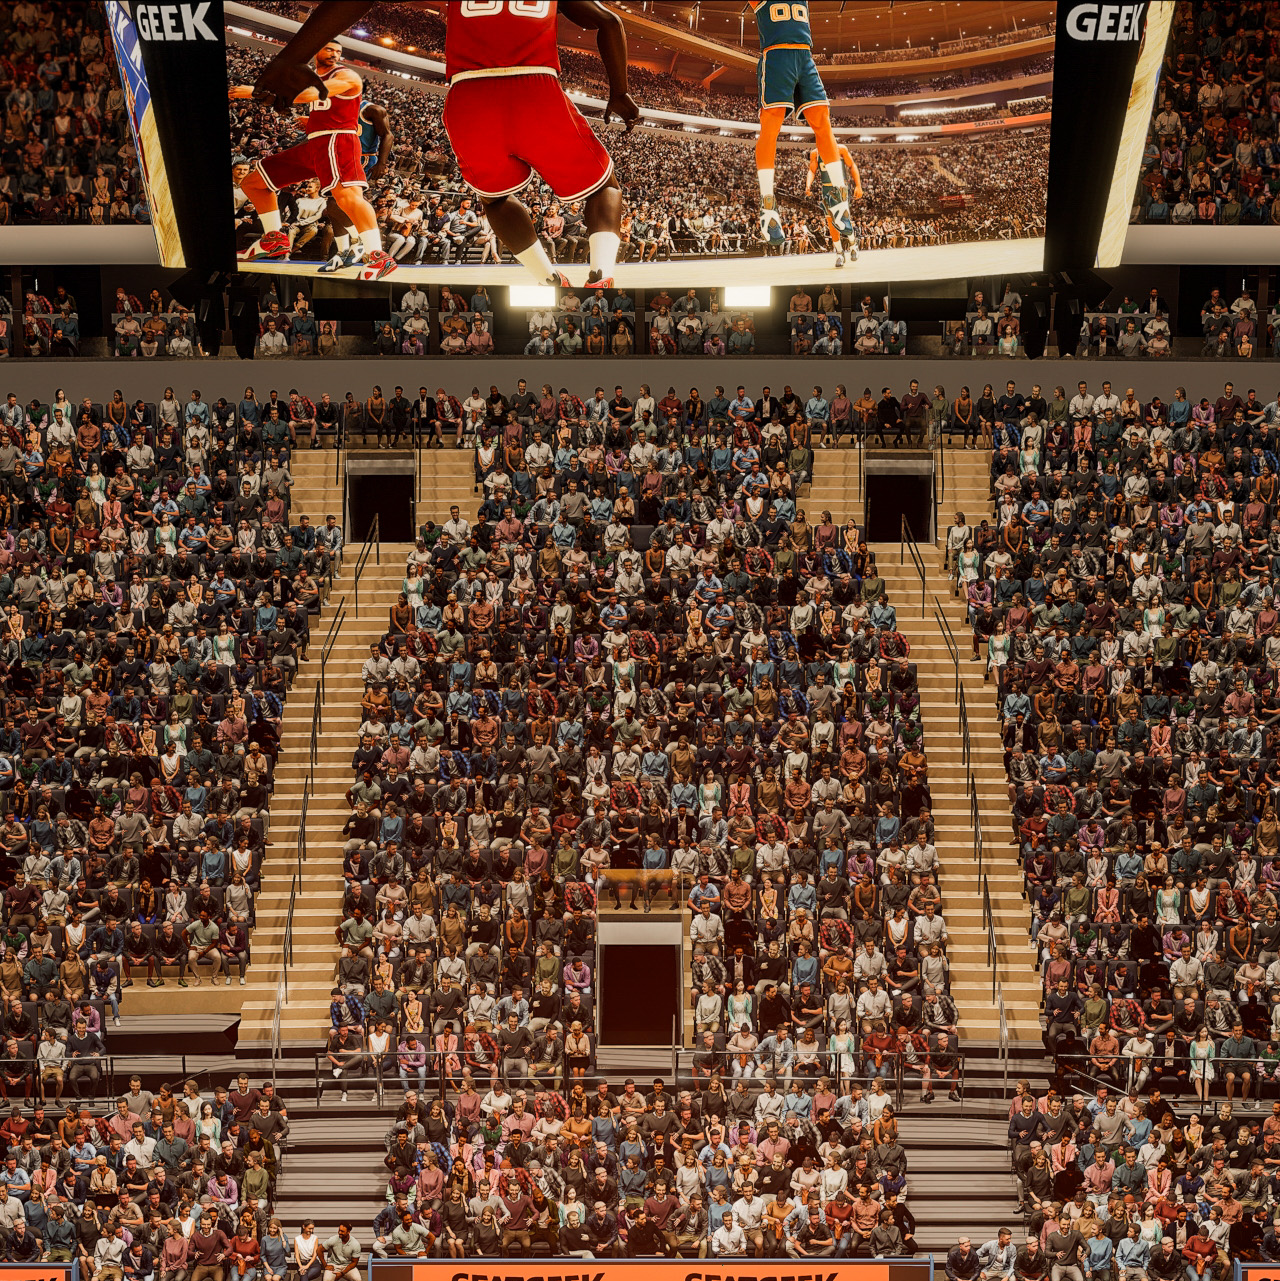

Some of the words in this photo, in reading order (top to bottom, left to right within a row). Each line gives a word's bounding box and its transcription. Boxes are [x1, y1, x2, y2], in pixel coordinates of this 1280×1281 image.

[136, 2, 219, 41] GEEK
[769, 3, 809, 22] 00
[1066, 3, 1145, 41] GEEK
[974, 119, 1005, 127] SEATGEEK
